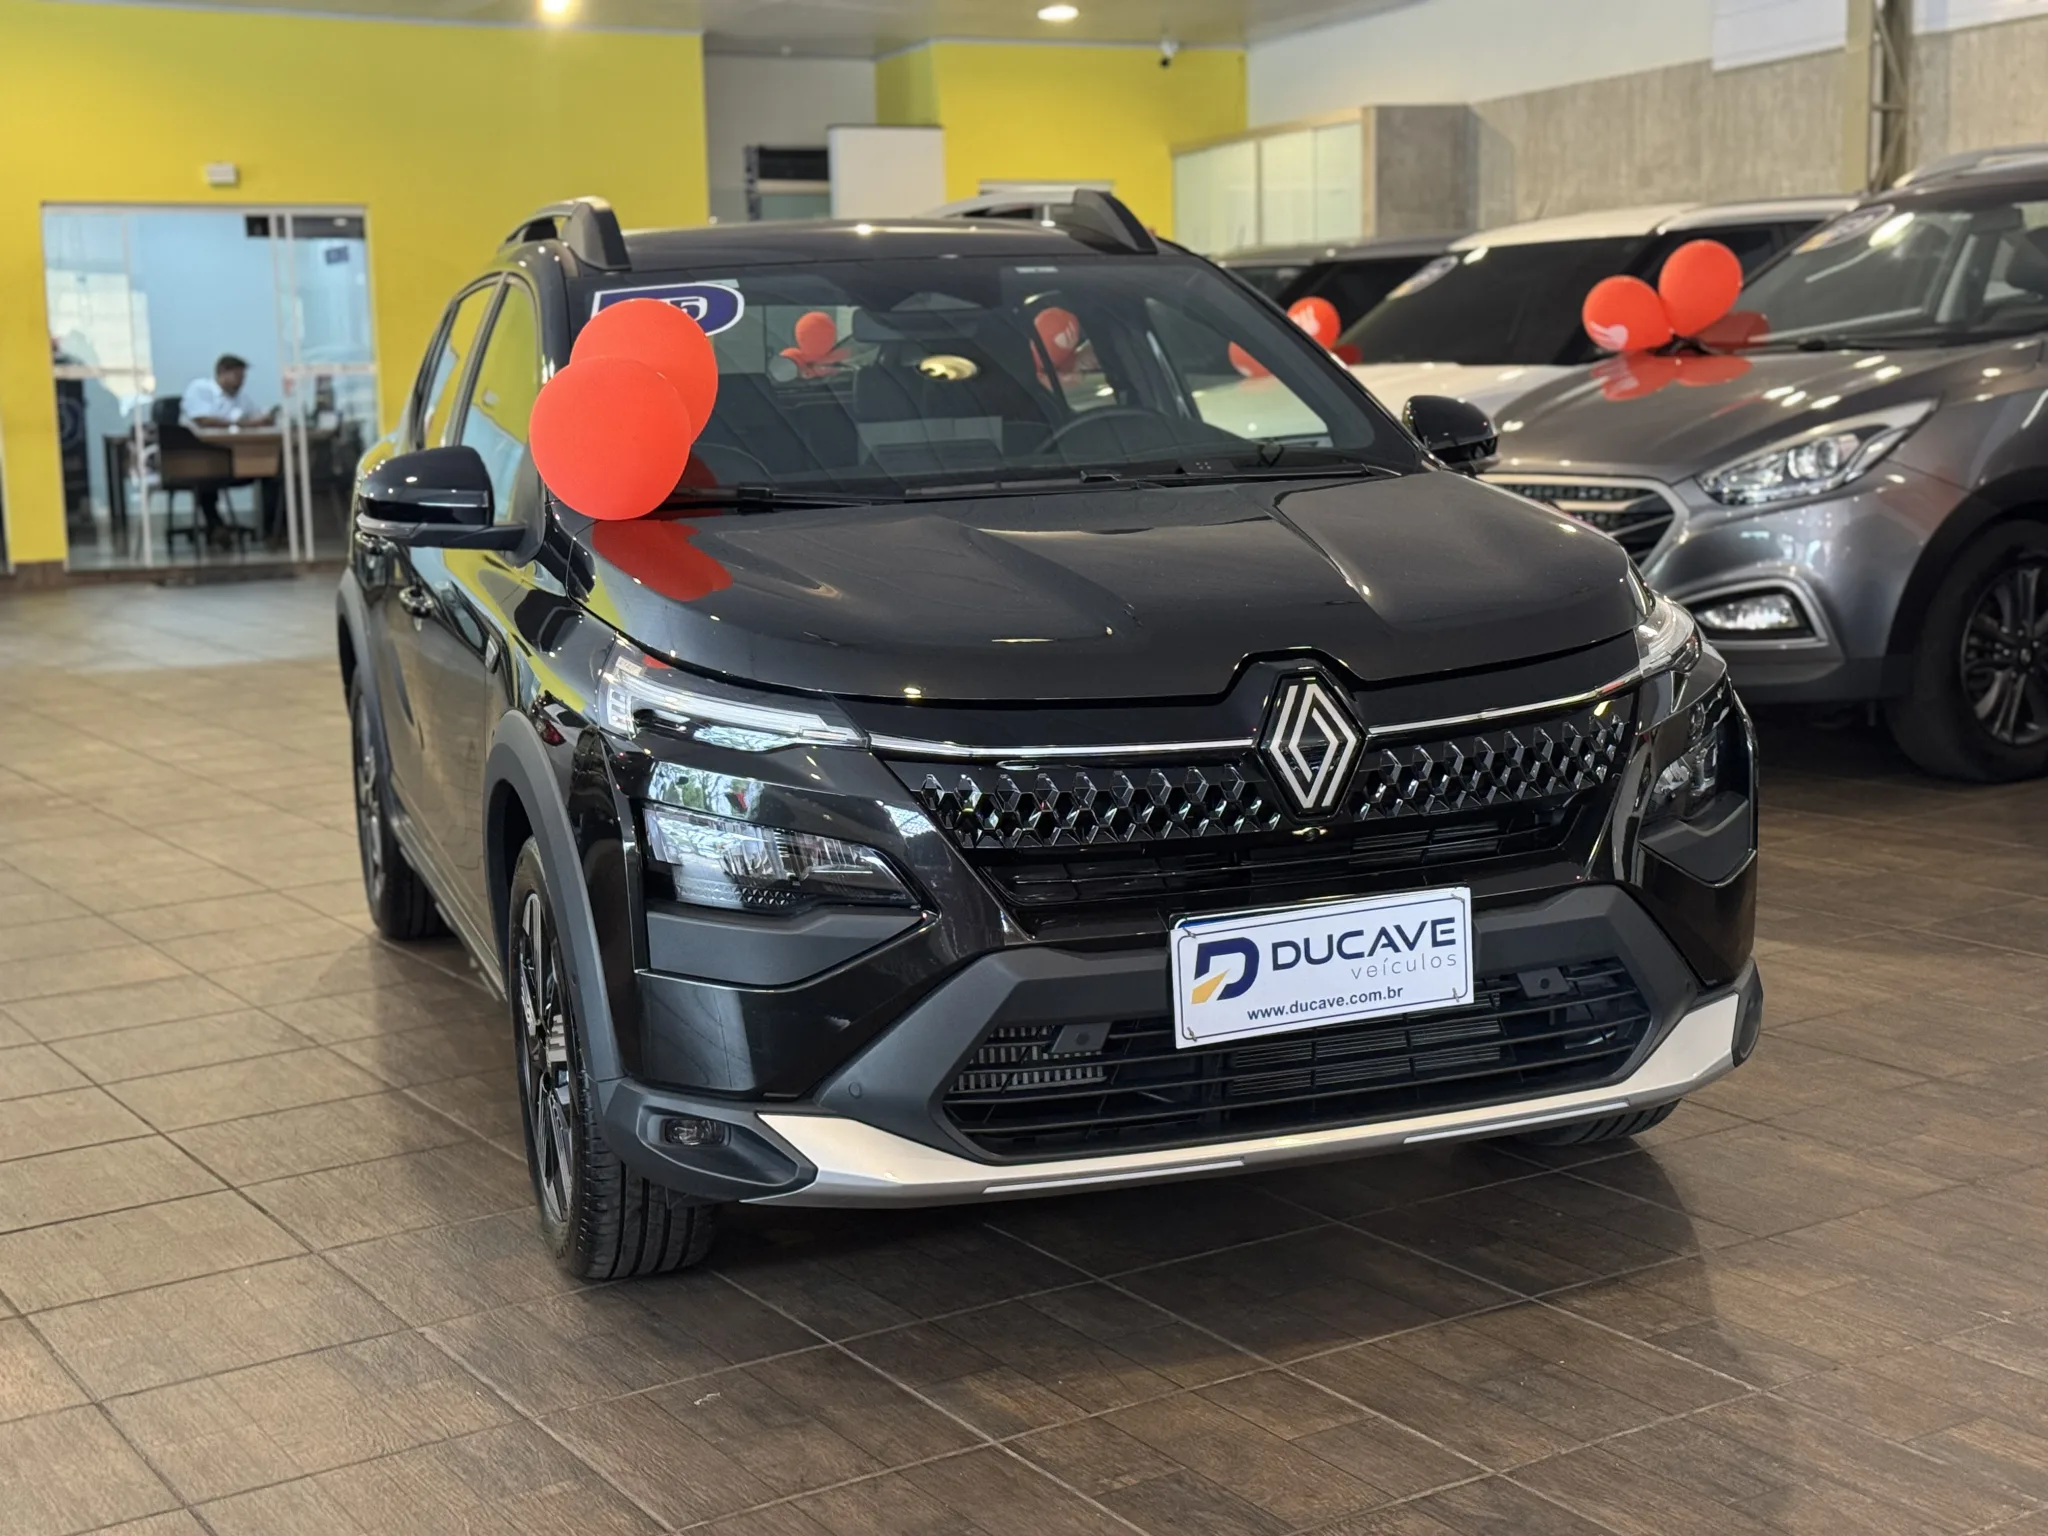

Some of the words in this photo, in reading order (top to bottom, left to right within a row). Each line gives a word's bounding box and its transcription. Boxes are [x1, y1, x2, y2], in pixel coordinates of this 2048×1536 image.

[1271, 917, 1457, 972] DUCAVE
[1351, 952, 1457, 980] veículos
[1247, 985, 1404, 1020] www.ducave.com.br
